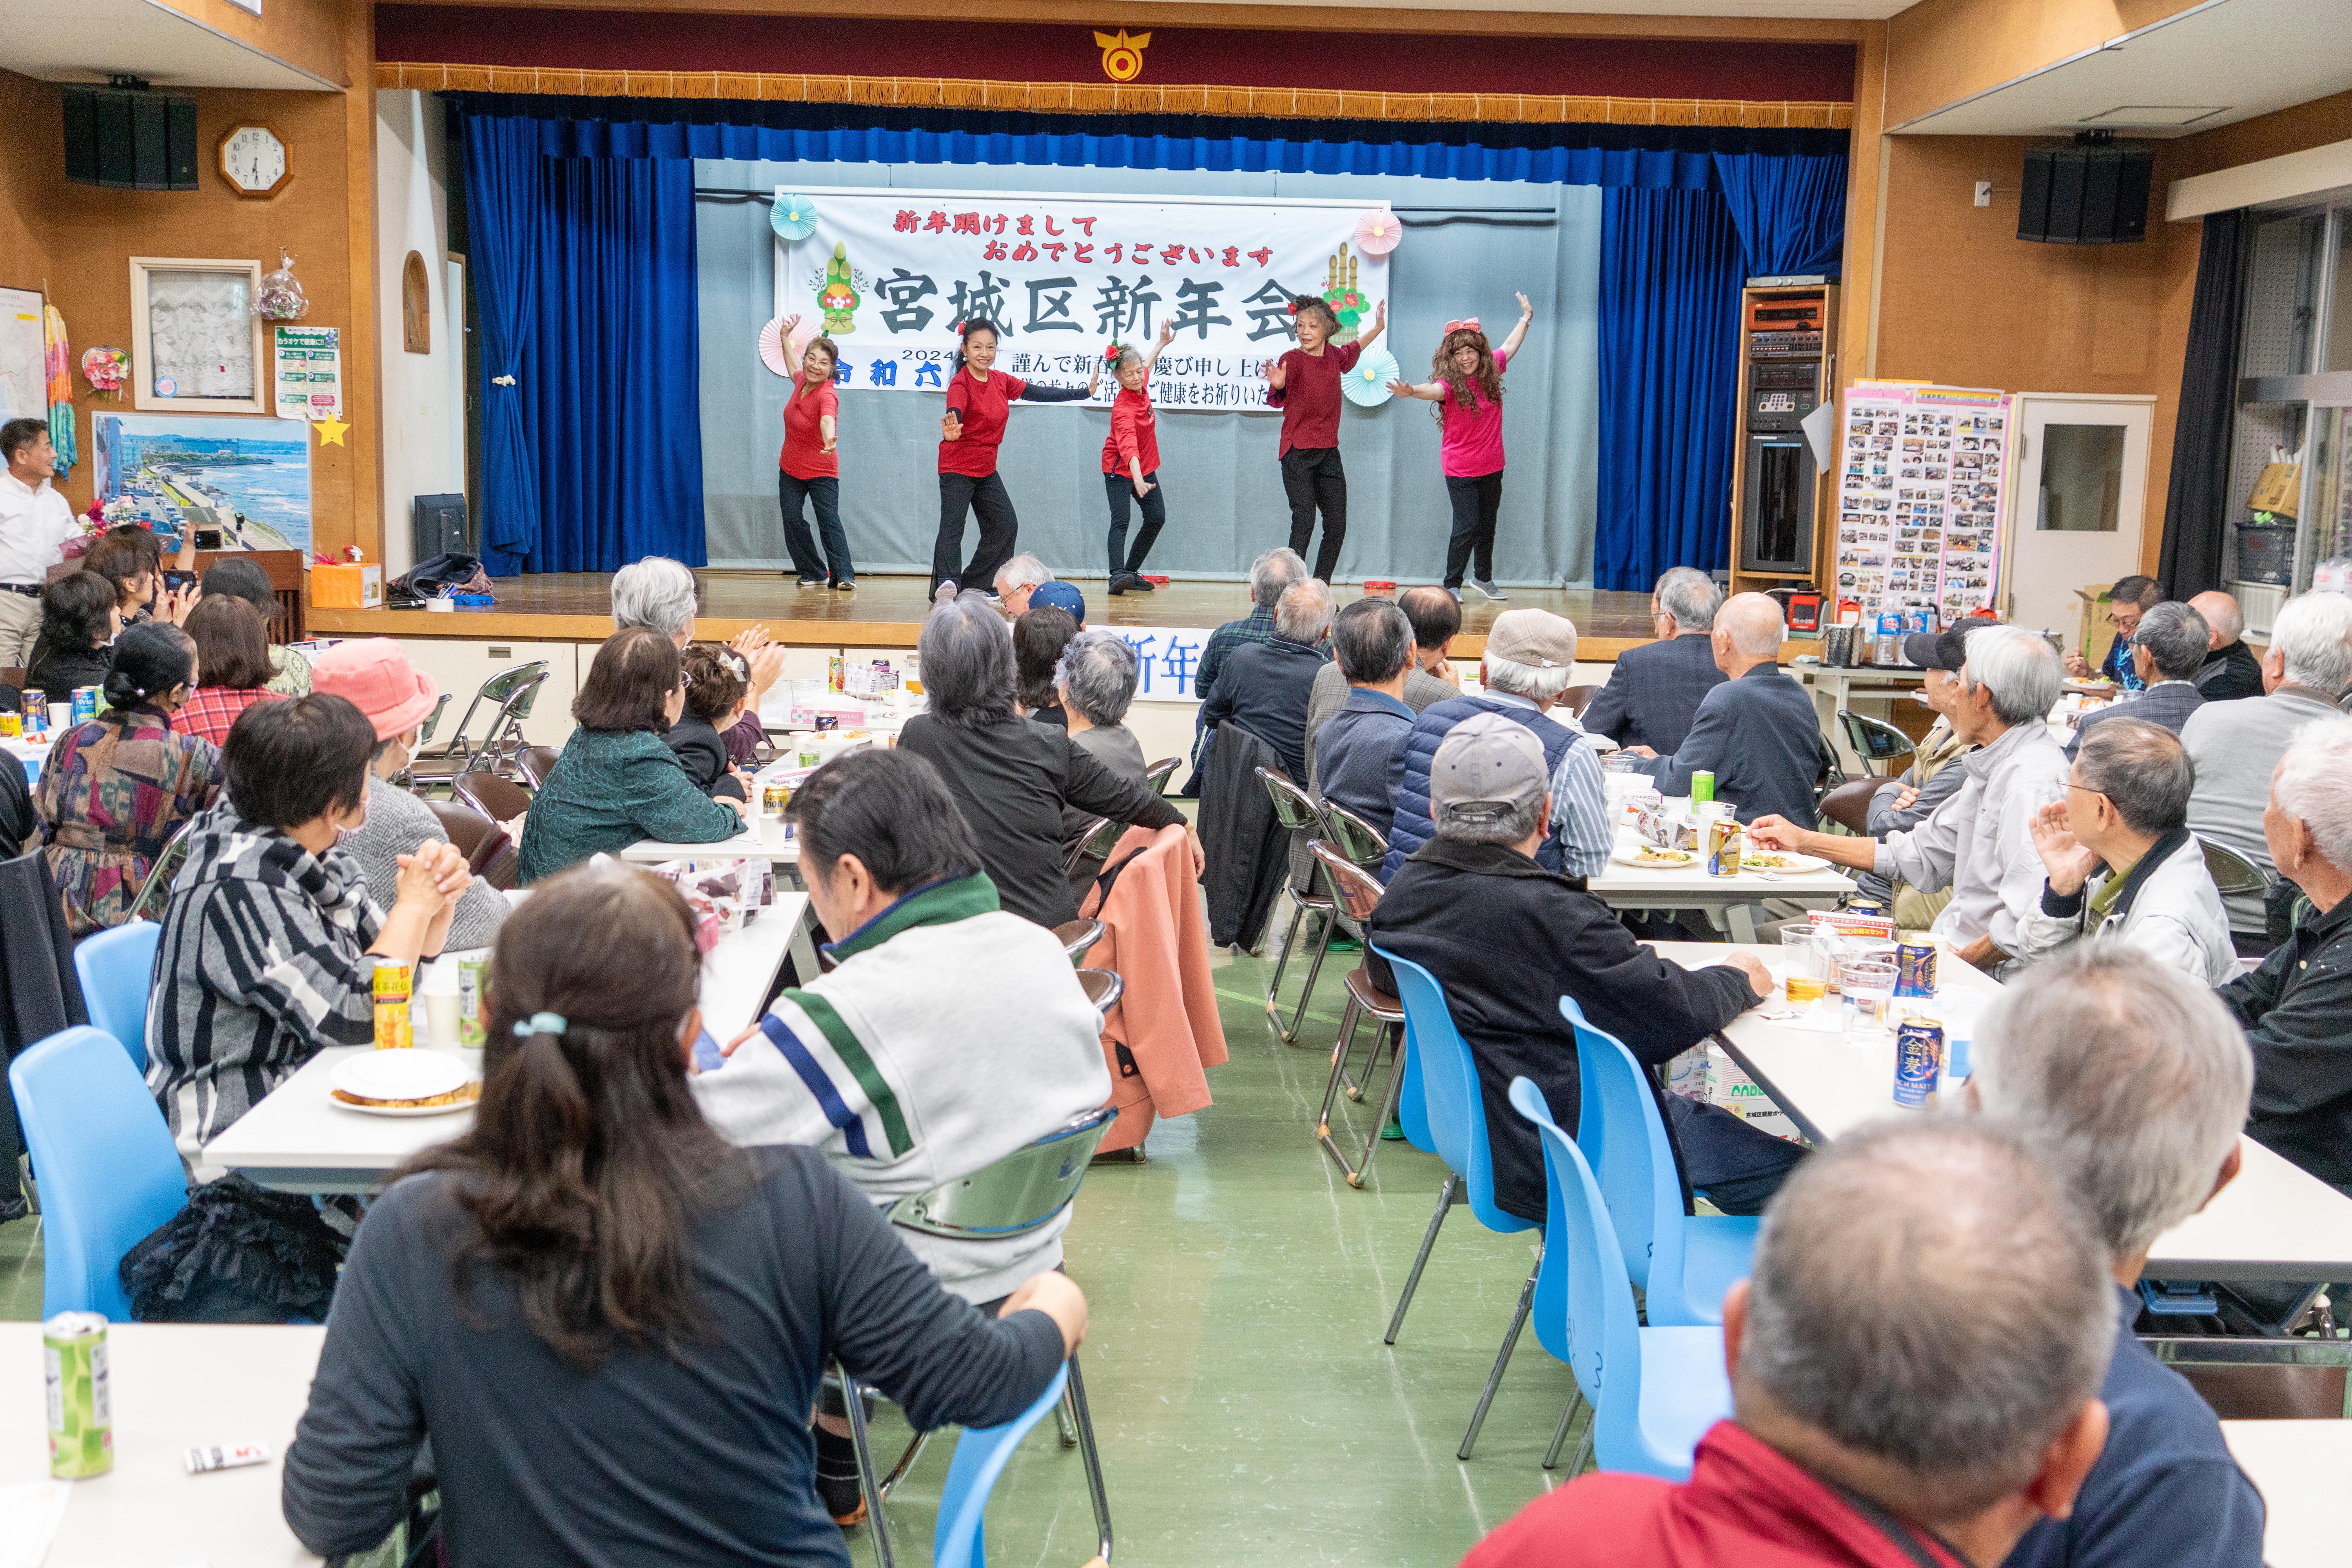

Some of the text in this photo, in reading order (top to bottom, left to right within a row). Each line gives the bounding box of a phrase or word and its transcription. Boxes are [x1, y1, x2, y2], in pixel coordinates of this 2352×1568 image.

[273, 143, 278, 152] 2
[231, 154, 236, 163] 9
[276, 155, 281, 164] 3
[243, 175, 248, 183] 7
[266, 175, 271, 184] 5
[893, 209, 1096, 237] 新年明けまして
[983, 240, 1273, 268] おめでとうございます
[874, 267, 1298, 342] 宮城区新年会
[902, 350, 954, 361] 2024
[1904, 1037, 1924, 1075] 金麦
